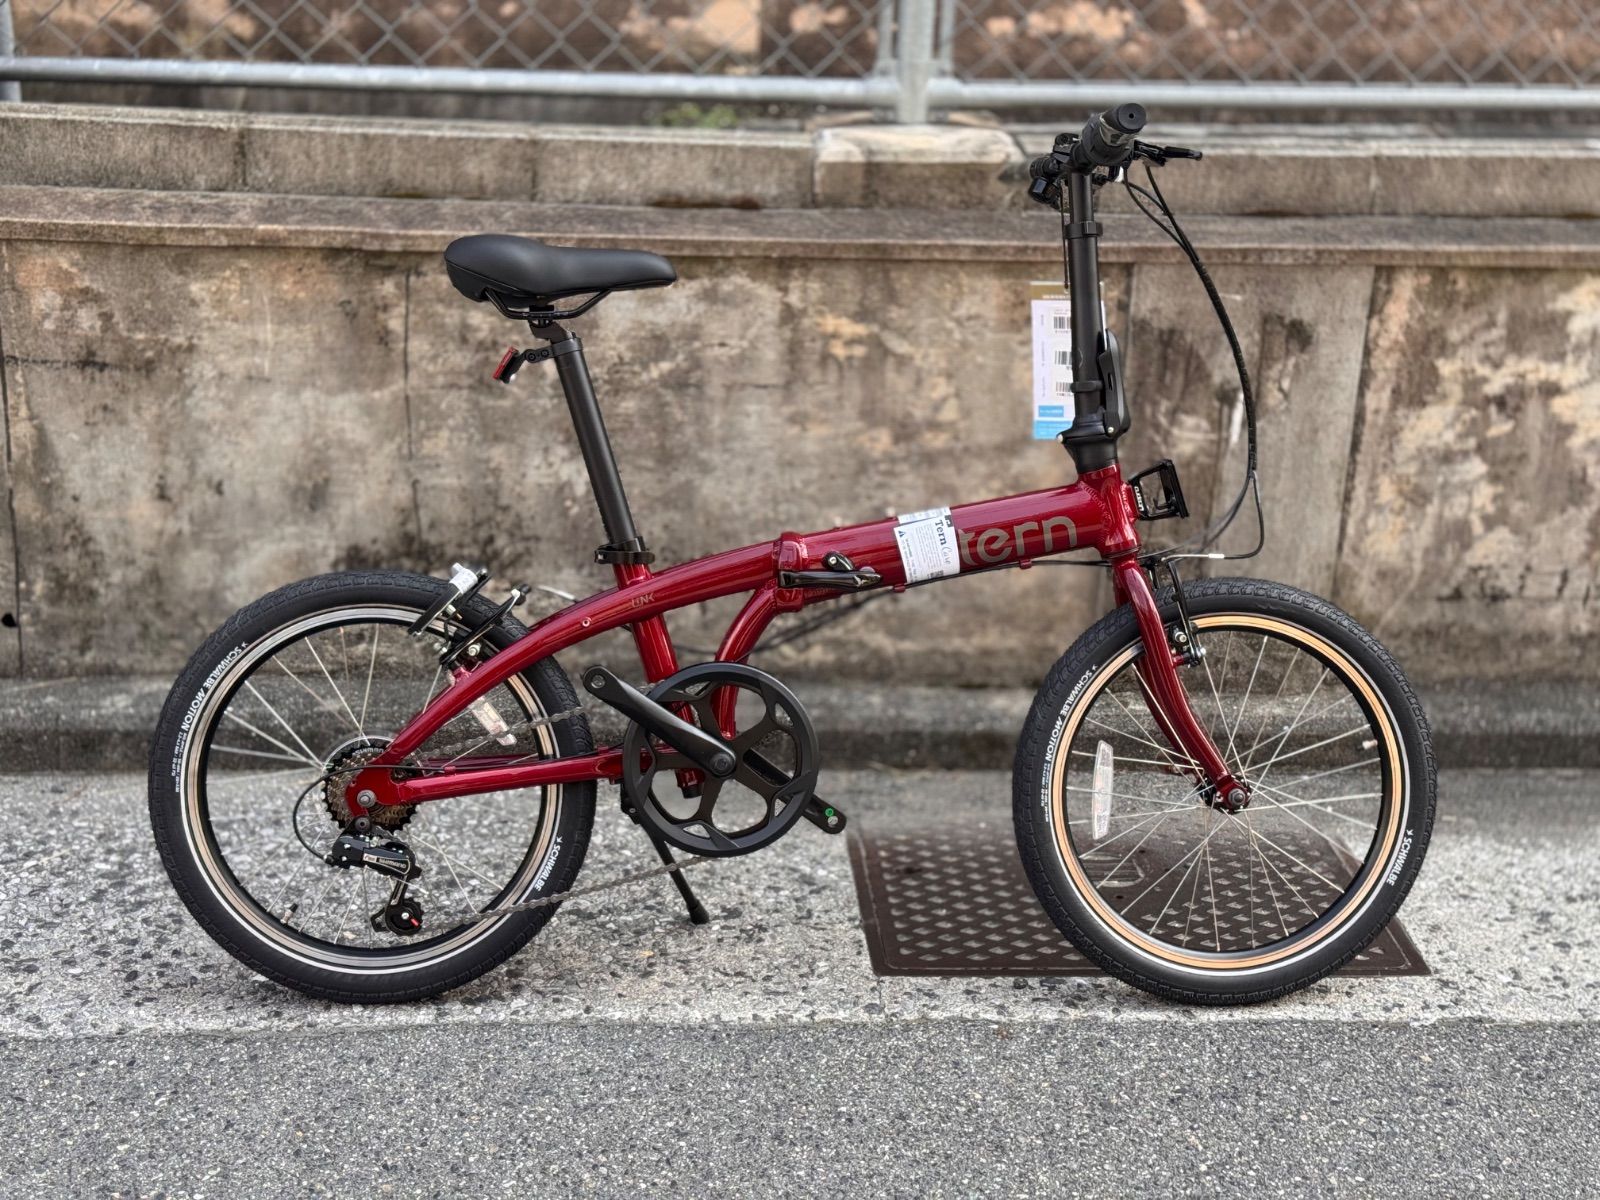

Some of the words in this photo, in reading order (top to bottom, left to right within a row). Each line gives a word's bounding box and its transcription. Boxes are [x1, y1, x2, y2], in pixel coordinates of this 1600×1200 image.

[935, 519, 948, 546] Tern
[957, 515, 1078, 566] tern
[203, 645, 242, 691] SCHWALBE
[180, 688, 206, 732] MOTION
[1060, 669, 1093, 719] SCHWALBE
[1045, 716, 1063, 762] MOTION
[534, 843, 561, 892] SCHWALBE
[1386, 836, 1413, 887] SCHWALBE
